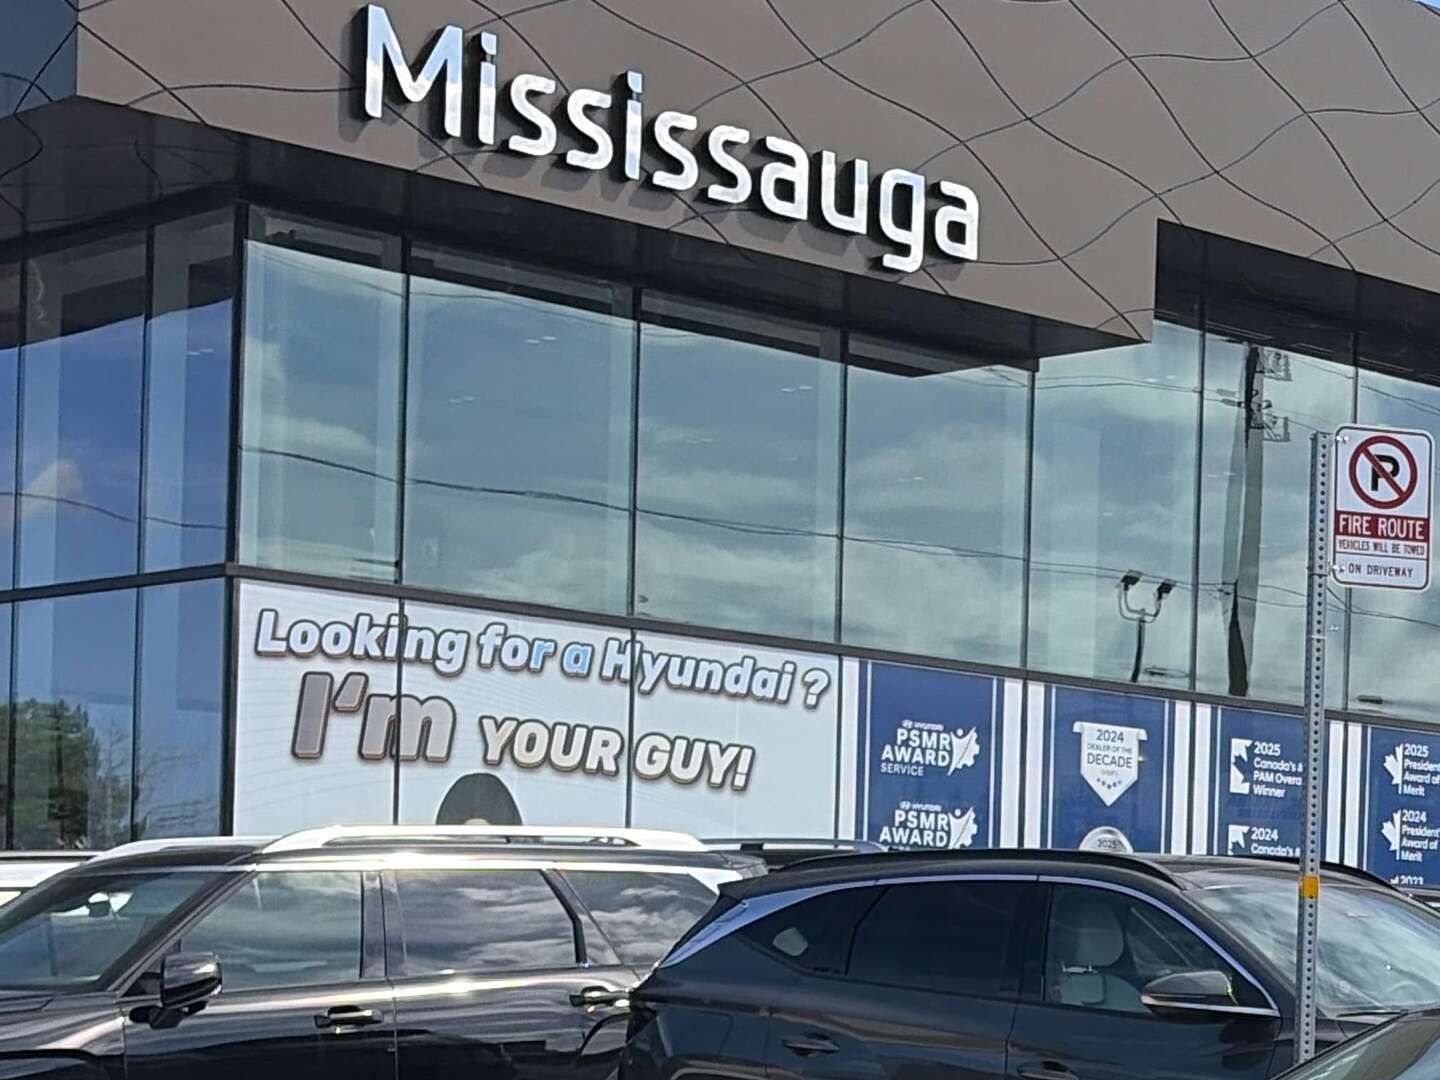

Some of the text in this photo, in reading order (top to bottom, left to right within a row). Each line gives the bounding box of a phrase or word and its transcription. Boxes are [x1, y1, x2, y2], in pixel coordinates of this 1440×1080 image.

[363, 3, 981, 274] Mississauga
[1339, 514, 1425, 539] FIRE ROUTE
[1339, 539, 1425, 556] VEHICLES WILL BE TOWED
[1348, 563, 1414, 578] ON DRIVEWAY
[255, 608, 469, 677] Looking
[477, 622, 556, 671] for
[560, 641, 594, 677] a
[291, 672, 755, 790] I'm YOUR GUY!
[1096, 729, 1124, 742] 2024
[896, 728, 951, 751] PSMR
[1088, 743, 1110, 751] DEALER
[881, 744, 950, 767] AWARD
[1254, 741, 1281, 756] 2025
[1404, 744, 1429, 757] 2025
[1087, 752, 1133, 769] DECADE
[1253, 757, 1296, 772] Canada's
[880, 762, 925, 776] SERVICE
[1253, 771, 1303, 786] PAM Overa
[1404, 772, 1440, 785] Award of
[1252, 784, 1285, 798] Winner
[1403, 785, 1425, 796] Merit
[894, 810, 949, 831] PSMR
[1402, 810, 1427, 823] 2024
[879, 826, 948, 848] AWARD
[1251, 827, 1279, 842] 2024
[1250, 843, 1294, 857] Canada's
[1401, 837, 1439, 850] Award of
[1401, 850, 1422, 862] Merit
